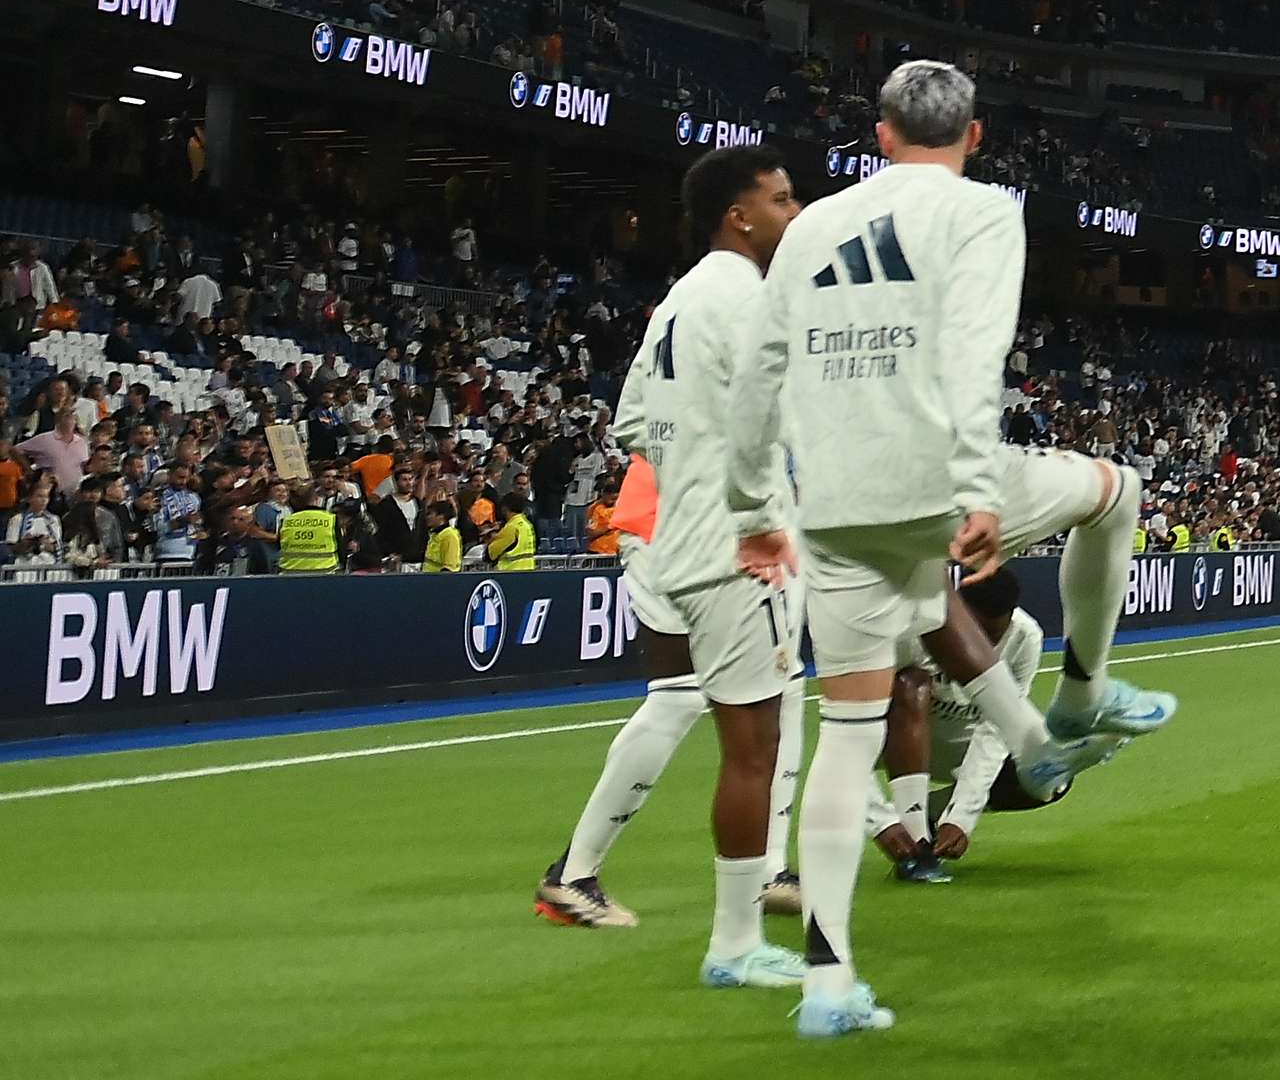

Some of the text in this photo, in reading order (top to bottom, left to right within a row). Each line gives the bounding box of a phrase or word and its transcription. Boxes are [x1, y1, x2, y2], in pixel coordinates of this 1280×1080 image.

[366, 35, 431, 85] BMW
[555, 82, 610, 126] BMW
[860, 154, 890, 183] BM
[1104, 206, 1137, 237] BMW
[807, 322, 917, 355] Emirates
[847, 354, 897, 380] BETTER
[284, 519, 329, 528] SEGURIDAD
[1125, 557, 1175, 616] BMW
[1232, 554, 1275, 606] BMW
[580, 576, 640, 661] BM
[46, 587, 229, 706] BMW
